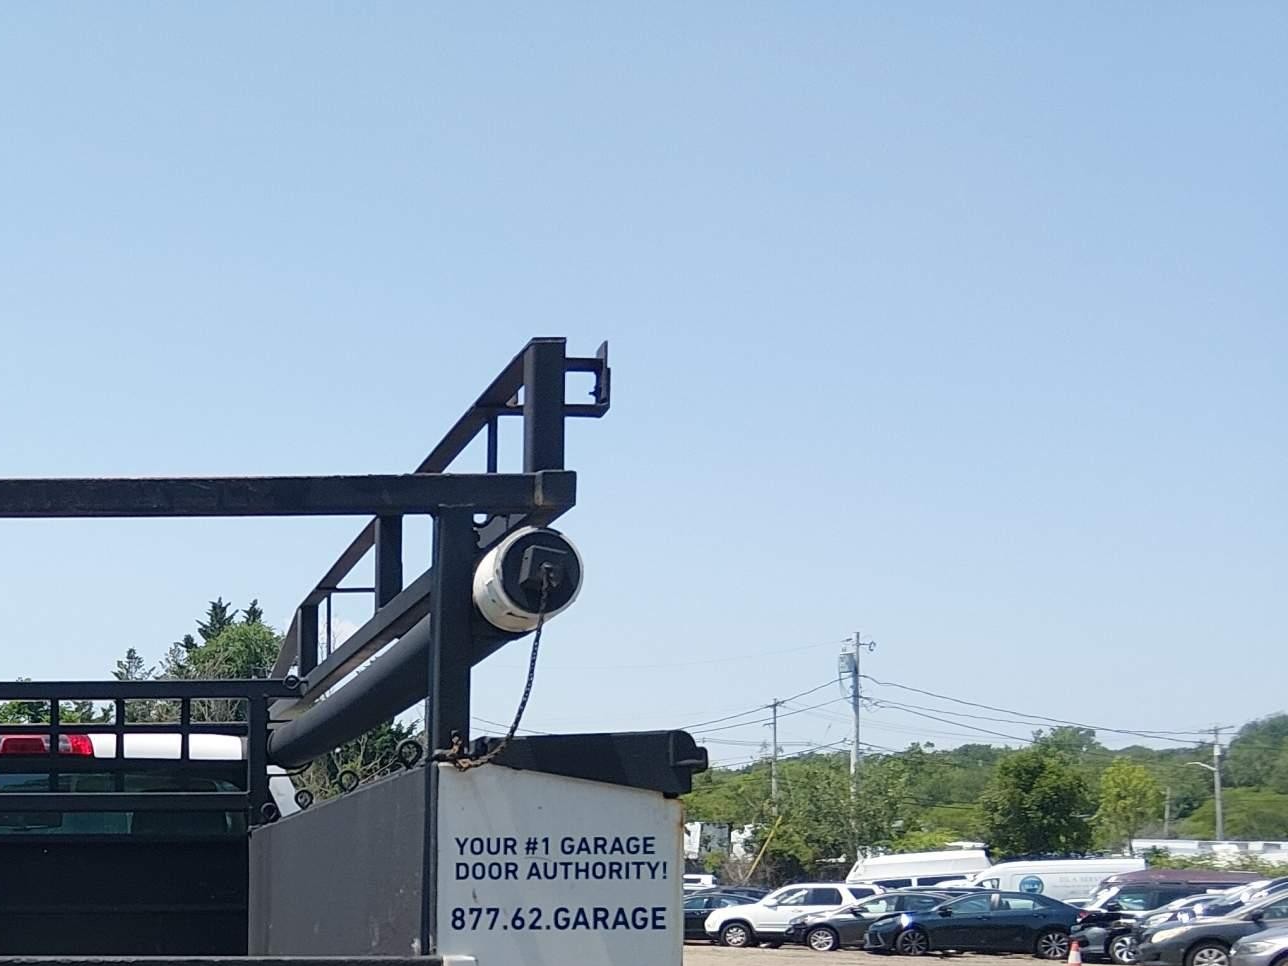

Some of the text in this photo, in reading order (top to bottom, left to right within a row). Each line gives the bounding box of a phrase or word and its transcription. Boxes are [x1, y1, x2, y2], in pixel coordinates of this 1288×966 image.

[455, 836, 656, 856] YOUR #1 GARAGE
[455, 861, 667, 881] DOOR AUTHORITY!
[451, 906, 667, 931] 877.62.GARAGE
